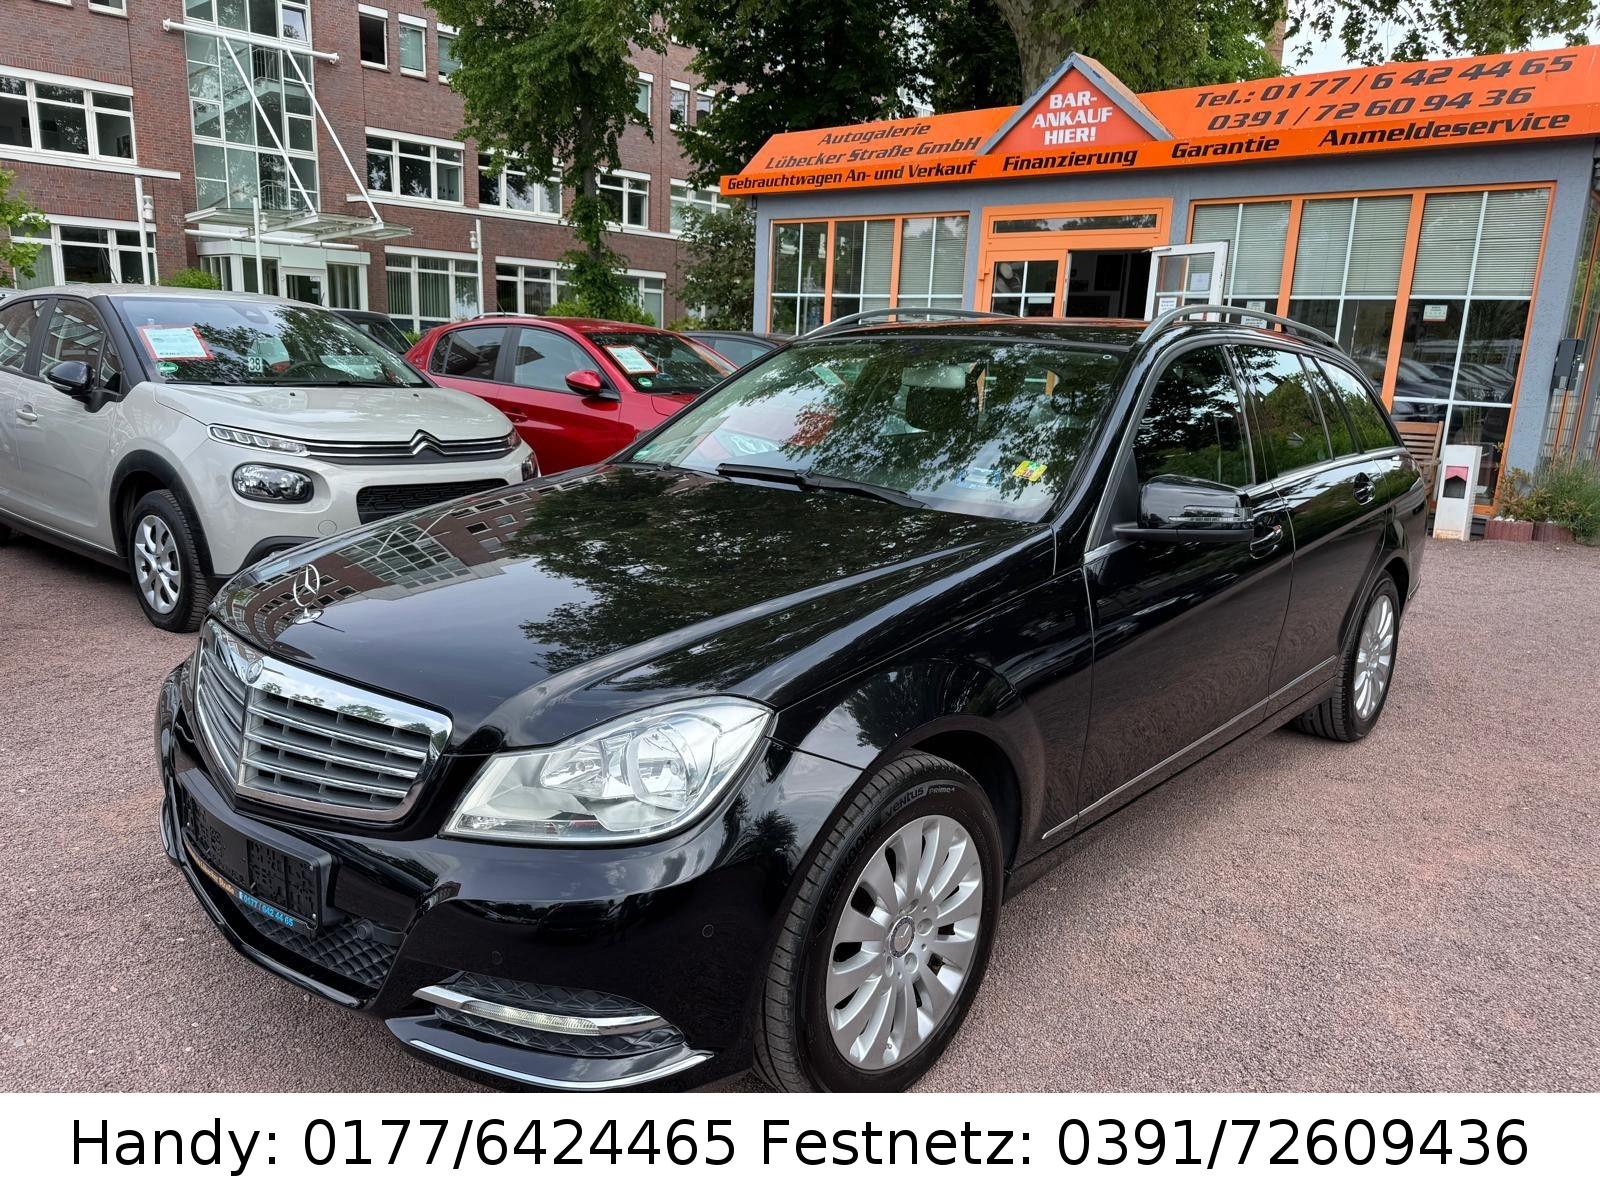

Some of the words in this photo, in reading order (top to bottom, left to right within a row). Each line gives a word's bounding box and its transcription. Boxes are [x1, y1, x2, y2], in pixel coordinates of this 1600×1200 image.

[1195, 90, 1256, 108] Tel.:
[1260, 76, 1351, 101] 0177
[1458, 60, 1513, 81] 44
[1519, 54, 1578, 76] 65
[1049, 90, 1098, 109] BAR-
[1207, 109, 1290, 131] 0391
[1314, 102, 1360, 121] 72
[1364, 97, 1416, 116] 60
[1420, 91, 1474, 112] 94
[1479, 86, 1536, 107] 36
[1032, 107, 1113, 129] ANKAUF
[1318, 112, 1570, 148] Anmeldeservice
[817, 122, 931, 146] Autogalerie
[1044, 127, 1097, 145] HIER!
[765, 152, 843, 170] Lübecker
[847, 143, 907, 163] Straße
[916, 136, 982, 156] GmbH
[1171, 136, 1280, 159] Garantie
[1002, 149, 1138, 172] Finanzierung
[727, 171, 842, 190] Gebrauchtwagen
[845, 169, 871, 183] An-
[874, 167, 903, 180] und
[908, 160, 977, 178] Verkauf
